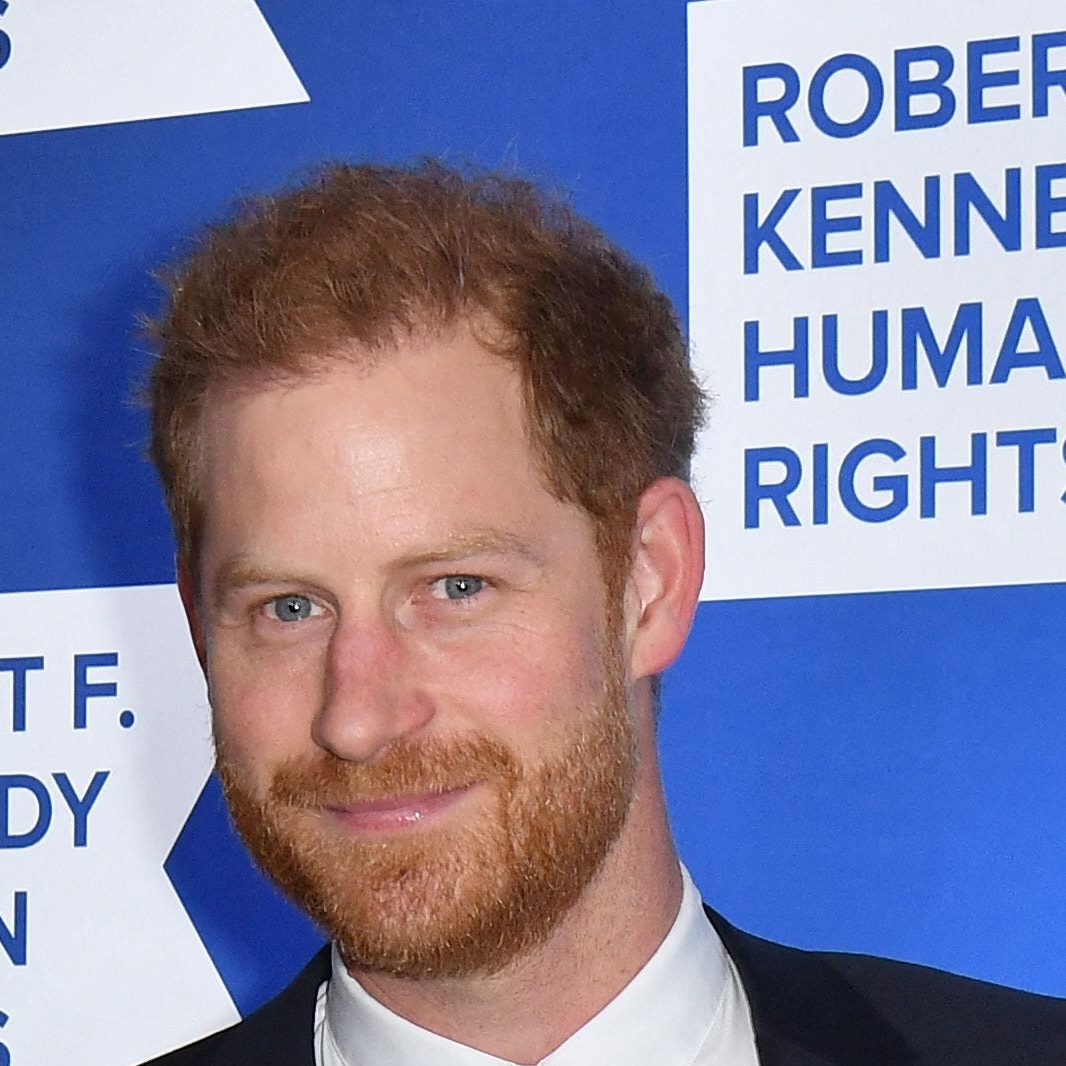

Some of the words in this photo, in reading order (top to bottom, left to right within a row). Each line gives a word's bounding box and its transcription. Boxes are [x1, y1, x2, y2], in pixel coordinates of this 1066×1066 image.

[744, 298, 1066, 401] HUMA
[745, 428, 1066, 529] RIGHT
[74, 652, 134, 729] F.
